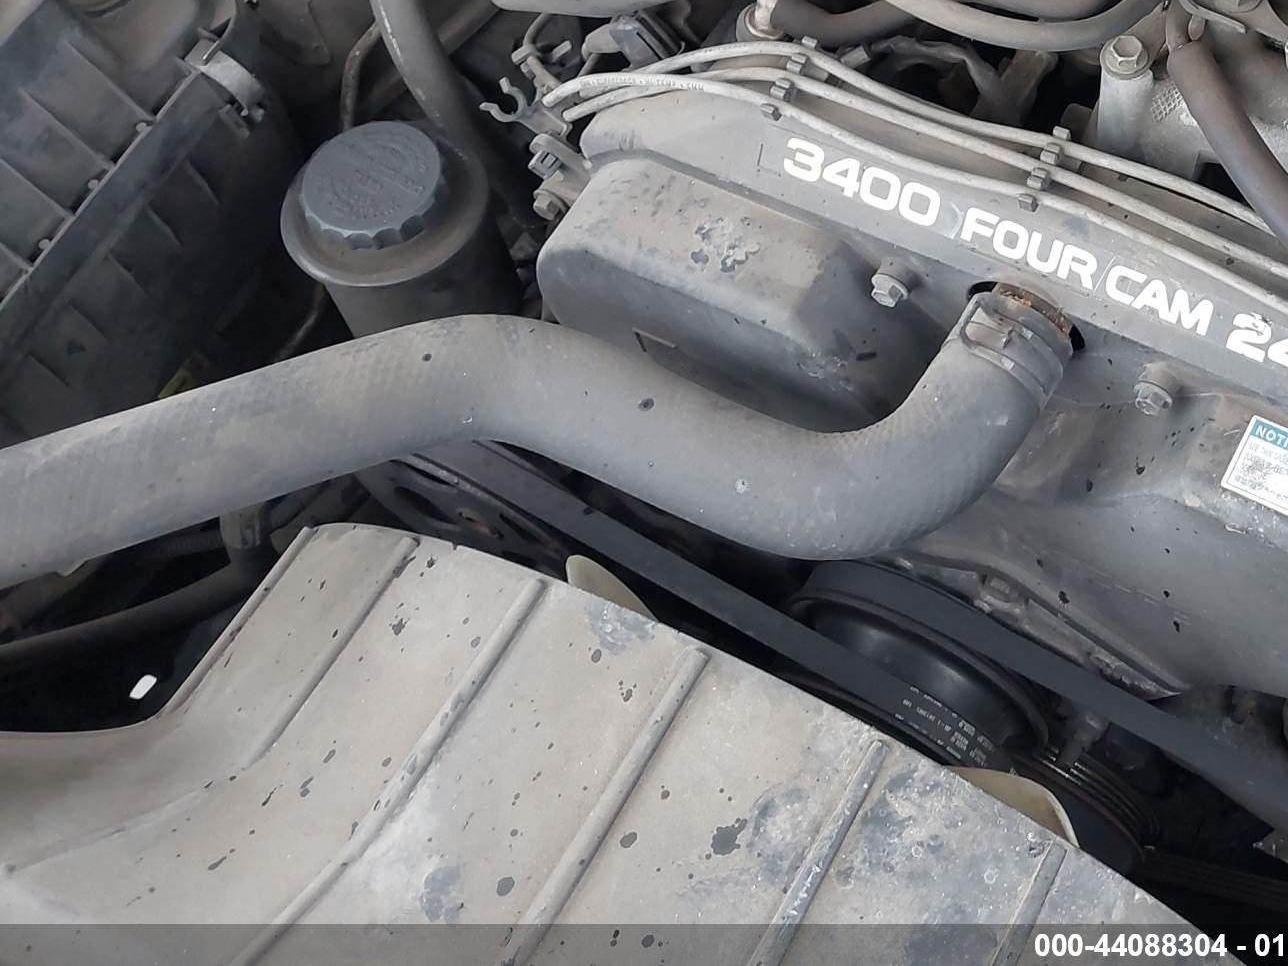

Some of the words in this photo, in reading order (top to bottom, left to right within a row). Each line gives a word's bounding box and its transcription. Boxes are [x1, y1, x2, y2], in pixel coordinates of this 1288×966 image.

[783, 137, 941, 227] 3400
[959, 205, 1099, 291] FOUR
[1105, 265, 1214, 336] CAM
